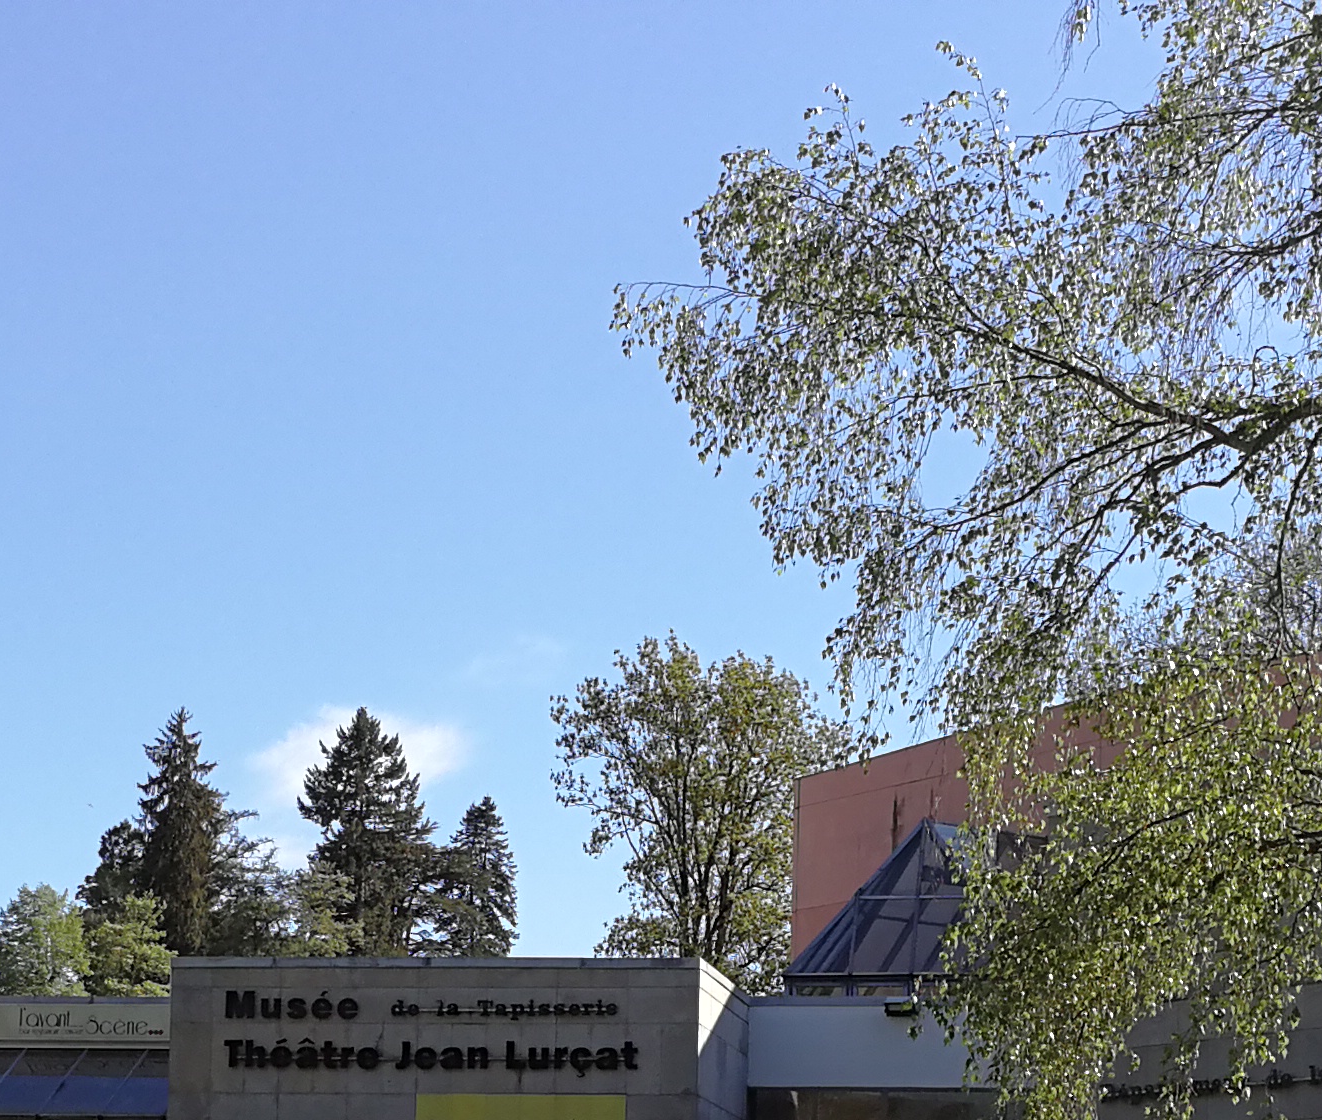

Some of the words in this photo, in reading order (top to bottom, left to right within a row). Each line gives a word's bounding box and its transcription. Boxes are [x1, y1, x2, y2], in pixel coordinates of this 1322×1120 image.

[225, 990, 360, 1020] Musée
[390, 1000, 420, 1018] de
[436, 1000, 461, 1018] la
[478, 1000, 618, 1020] Tapisserie
[225, 1037, 378, 1070] Théâtre
[395, 1041, 489, 1070] Jean
[506, 1041, 639, 1078] Lurçat
